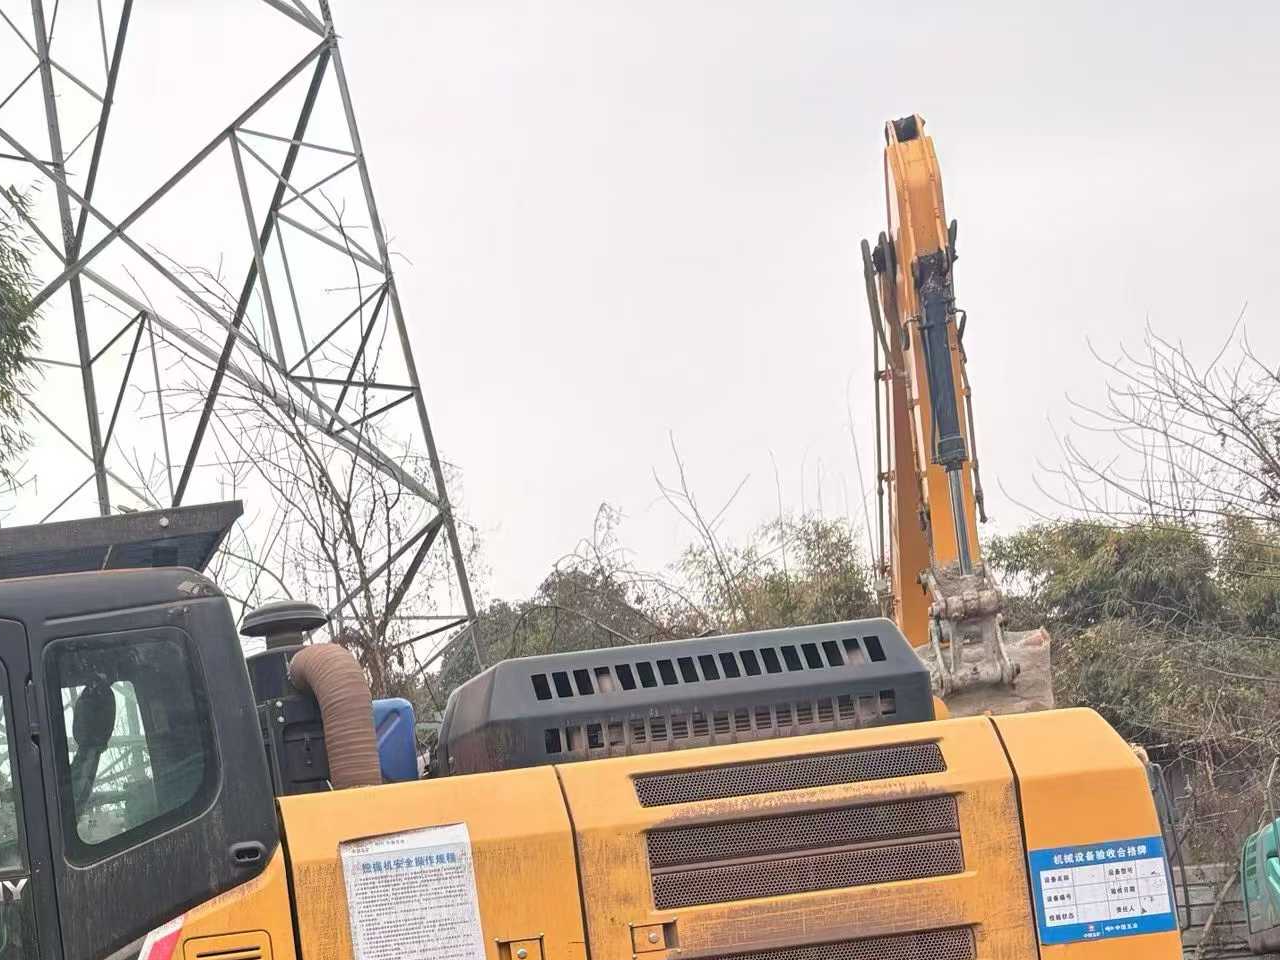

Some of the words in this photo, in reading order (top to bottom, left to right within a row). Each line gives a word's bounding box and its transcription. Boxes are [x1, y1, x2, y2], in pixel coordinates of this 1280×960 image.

[1053, 844, 1147, 865] 机械设备验收合格牌
